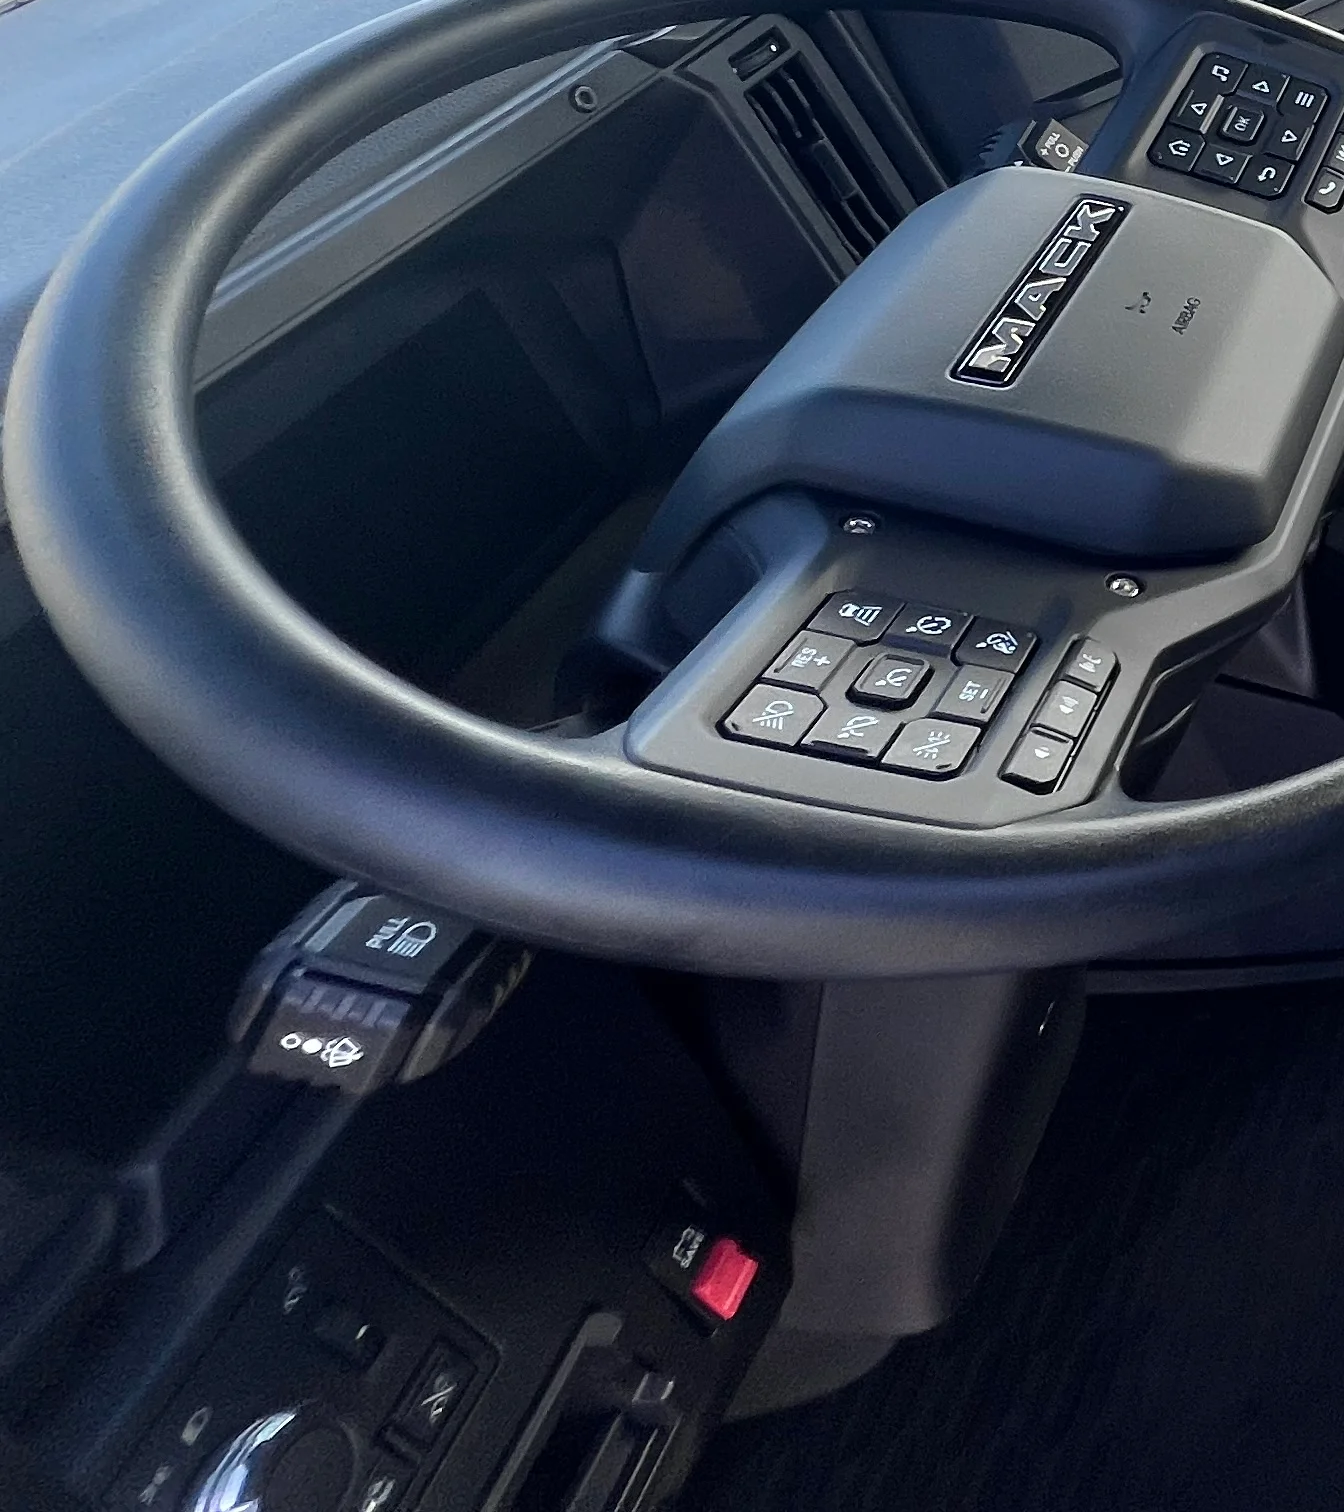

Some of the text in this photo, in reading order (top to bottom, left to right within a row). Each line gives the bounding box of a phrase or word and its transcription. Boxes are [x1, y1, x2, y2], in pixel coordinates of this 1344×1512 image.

[1234, 115, 1252, 132] OK
[969, 204, 1116, 372] MACK
[1171, 297, 1201, 335] AIRBAG
[791, 647, 817, 668] RES
[958, 680, 981, 702] SET
[365, 916, 411, 949] PULL
